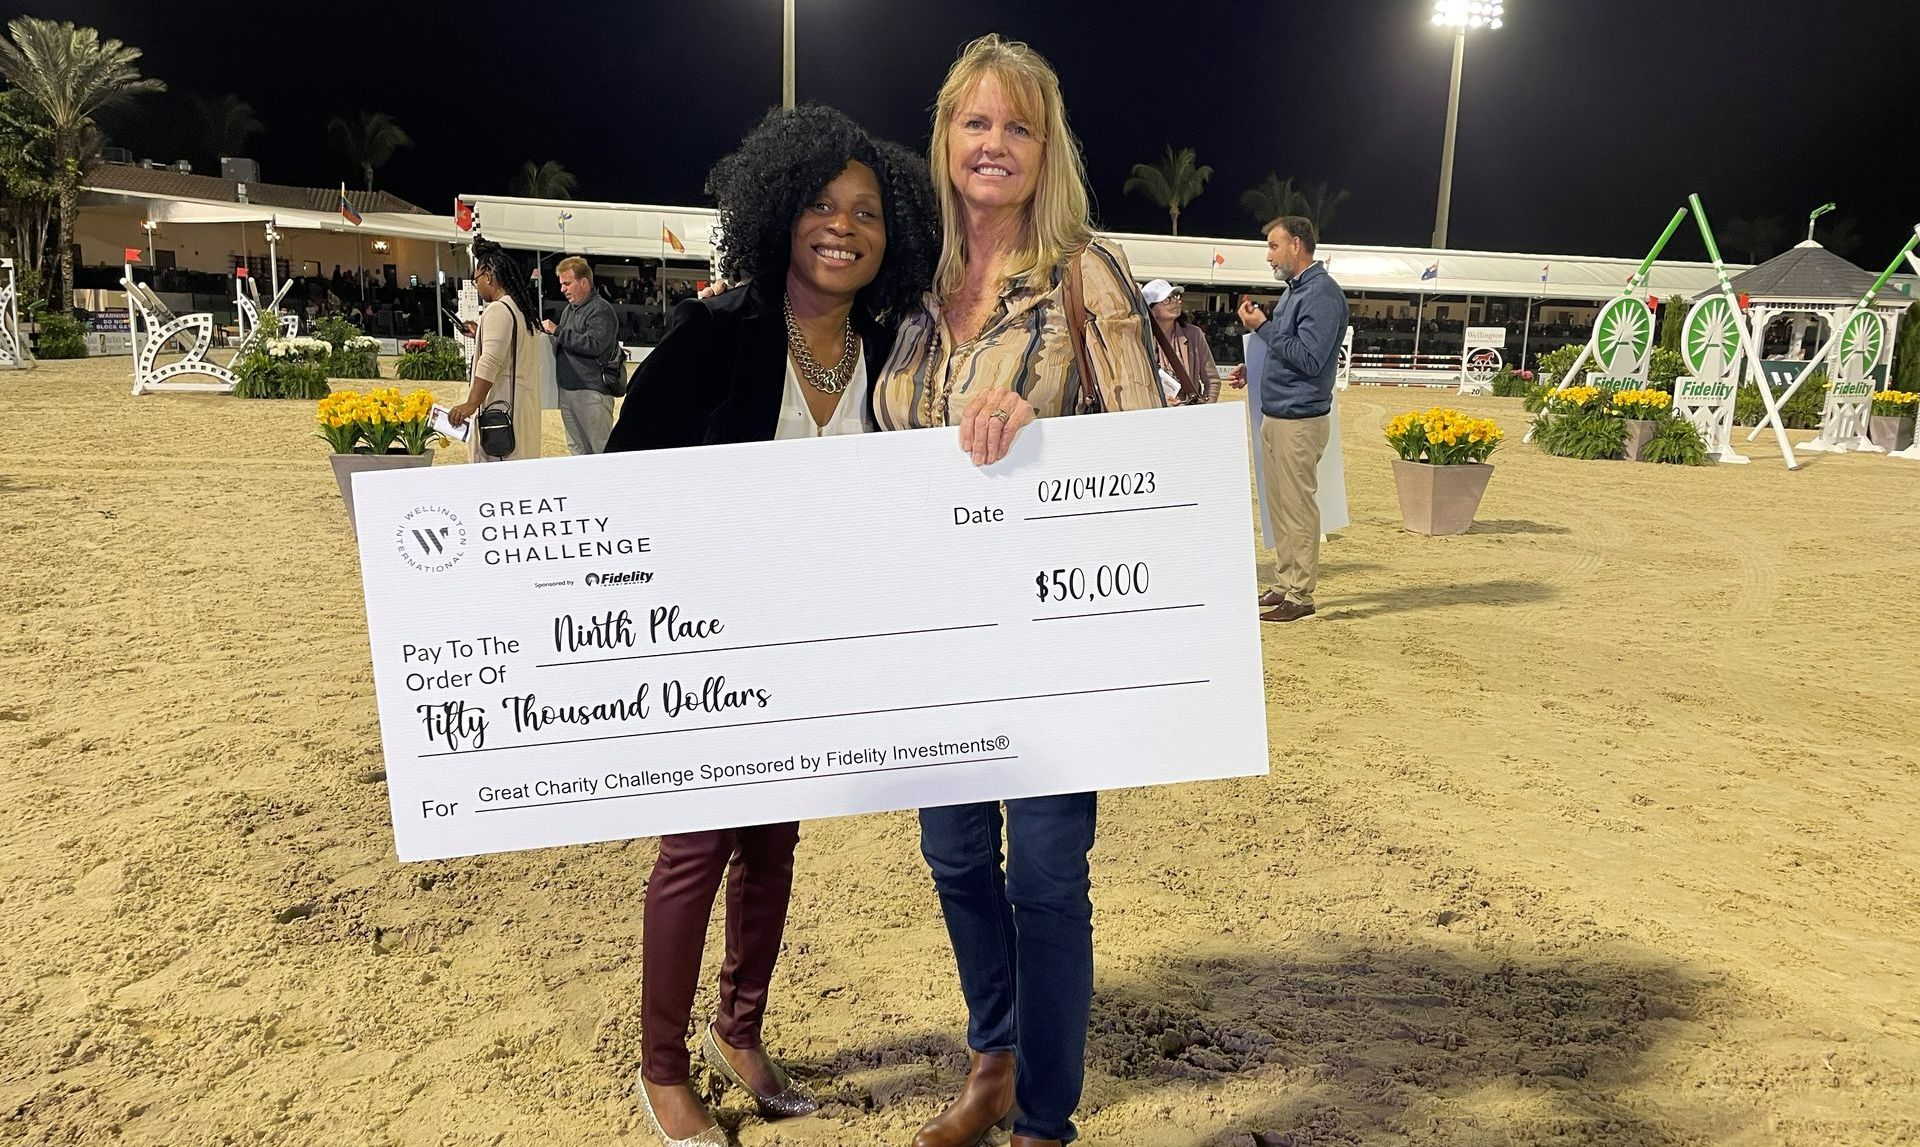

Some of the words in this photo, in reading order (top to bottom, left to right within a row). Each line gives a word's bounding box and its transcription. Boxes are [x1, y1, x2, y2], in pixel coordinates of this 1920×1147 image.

[1471, 388, 1480, 396] 20
[1682, 381, 1734, 399] Fidelity
[1833, 381, 1873, 397] Fidelity
[479, 497, 568, 518] GREAT
[954, 506, 1004, 525] Date
[1038, 472, 1156, 502] 02/04/2023
[404, 505, 467, 546] WELLINGTON
[481, 517, 610, 541] CHARITY
[396, 525, 465, 573] INTERNATIONAL
[484, 537, 652, 565] CHALLENGE
[534, 580, 566, 588] Sponsored
[601, 571, 654, 583] Fidelity
[1036, 562, 1149, 603] $50,000
[554, 610, 636, 652] Ninth
[650, 605, 725, 643] Place
[402, 644, 442, 664] Pay
[446, 640, 473, 658] To
[477, 637, 520, 655] The
[406, 670, 473, 692] Order
[479, 664, 507, 685] Of
[416, 701, 489, 751] Fifty
[502, 683, 649, 733] Thousand
[662, 675, 772, 718] Dollars
[422, 799, 459, 819] For
[478, 784, 530, 802] Great
[535, 777, 598, 796] Charity
[604, 769, 694, 790] Challenge
[700, 756, 795, 781] Sponsored
[800, 754, 821, 772] by
[826, 748, 888, 767] Fidelity
[892, 735, 1010, 760] Investments®
